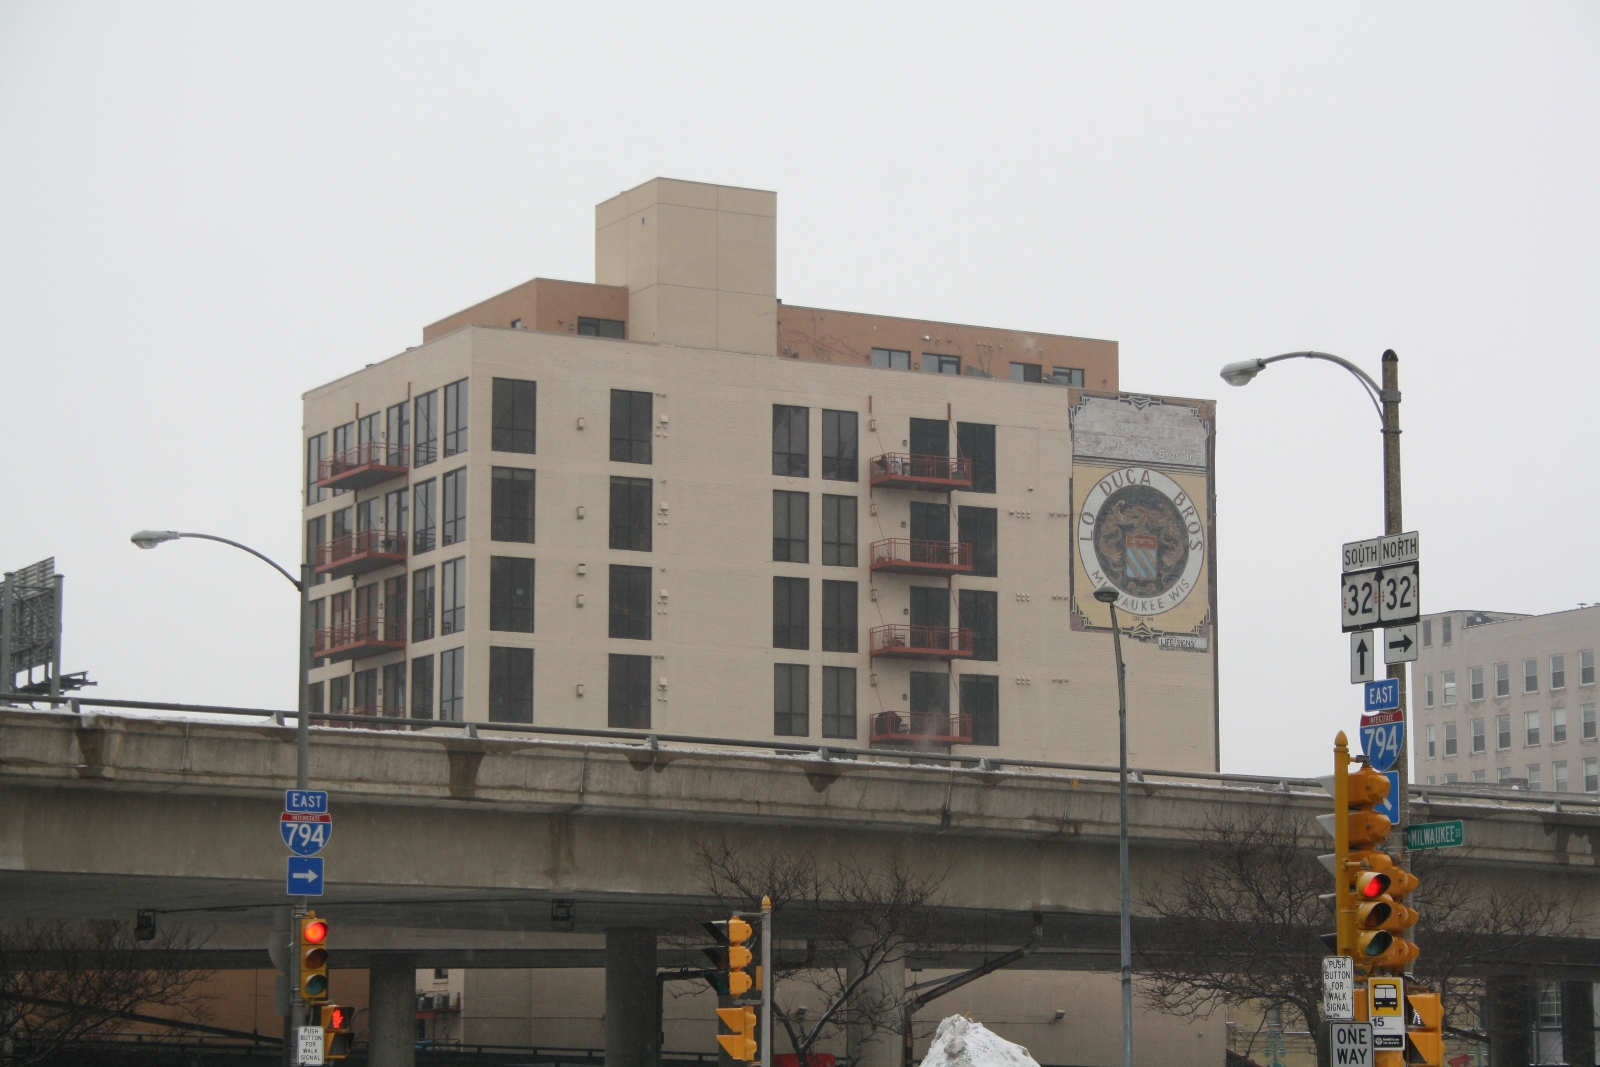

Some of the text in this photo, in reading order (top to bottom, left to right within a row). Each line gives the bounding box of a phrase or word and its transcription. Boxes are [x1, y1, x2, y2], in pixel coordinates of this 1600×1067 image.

[1079, 511, 1095, 541] LO
[1098, 468, 1151, 497] DUCA
[1344, 537, 1417, 566] SOUTH NORTH
[1168, 578, 1190, 602] WIS
[1347, 575, 1411, 616] 32 32
[1369, 685, 1393, 705] EAST
[1368, 713, 1394, 724] INTERSTATE
[1364, 725, 1398, 760] 794
[292, 792, 322, 808] EAST
[285, 823, 325, 848] 794
[1411, 826, 1455, 847] MILWAUKEE
[1455, 828, 1461, 838] ST
[1328, 960, 1346, 969] PUSH
[1325, 971, 1351, 980] BUTTON
[1331, 982, 1344, 990] FOR
[1328, 992, 1347, 1001] WALK
[1326, 1003, 1350, 1012] SIGNAL
[1371, 1017, 1385, 1027] 15
[1337, 1028, 1368, 1045] ONE
[1337, 1048, 1368, 1065] WAY
